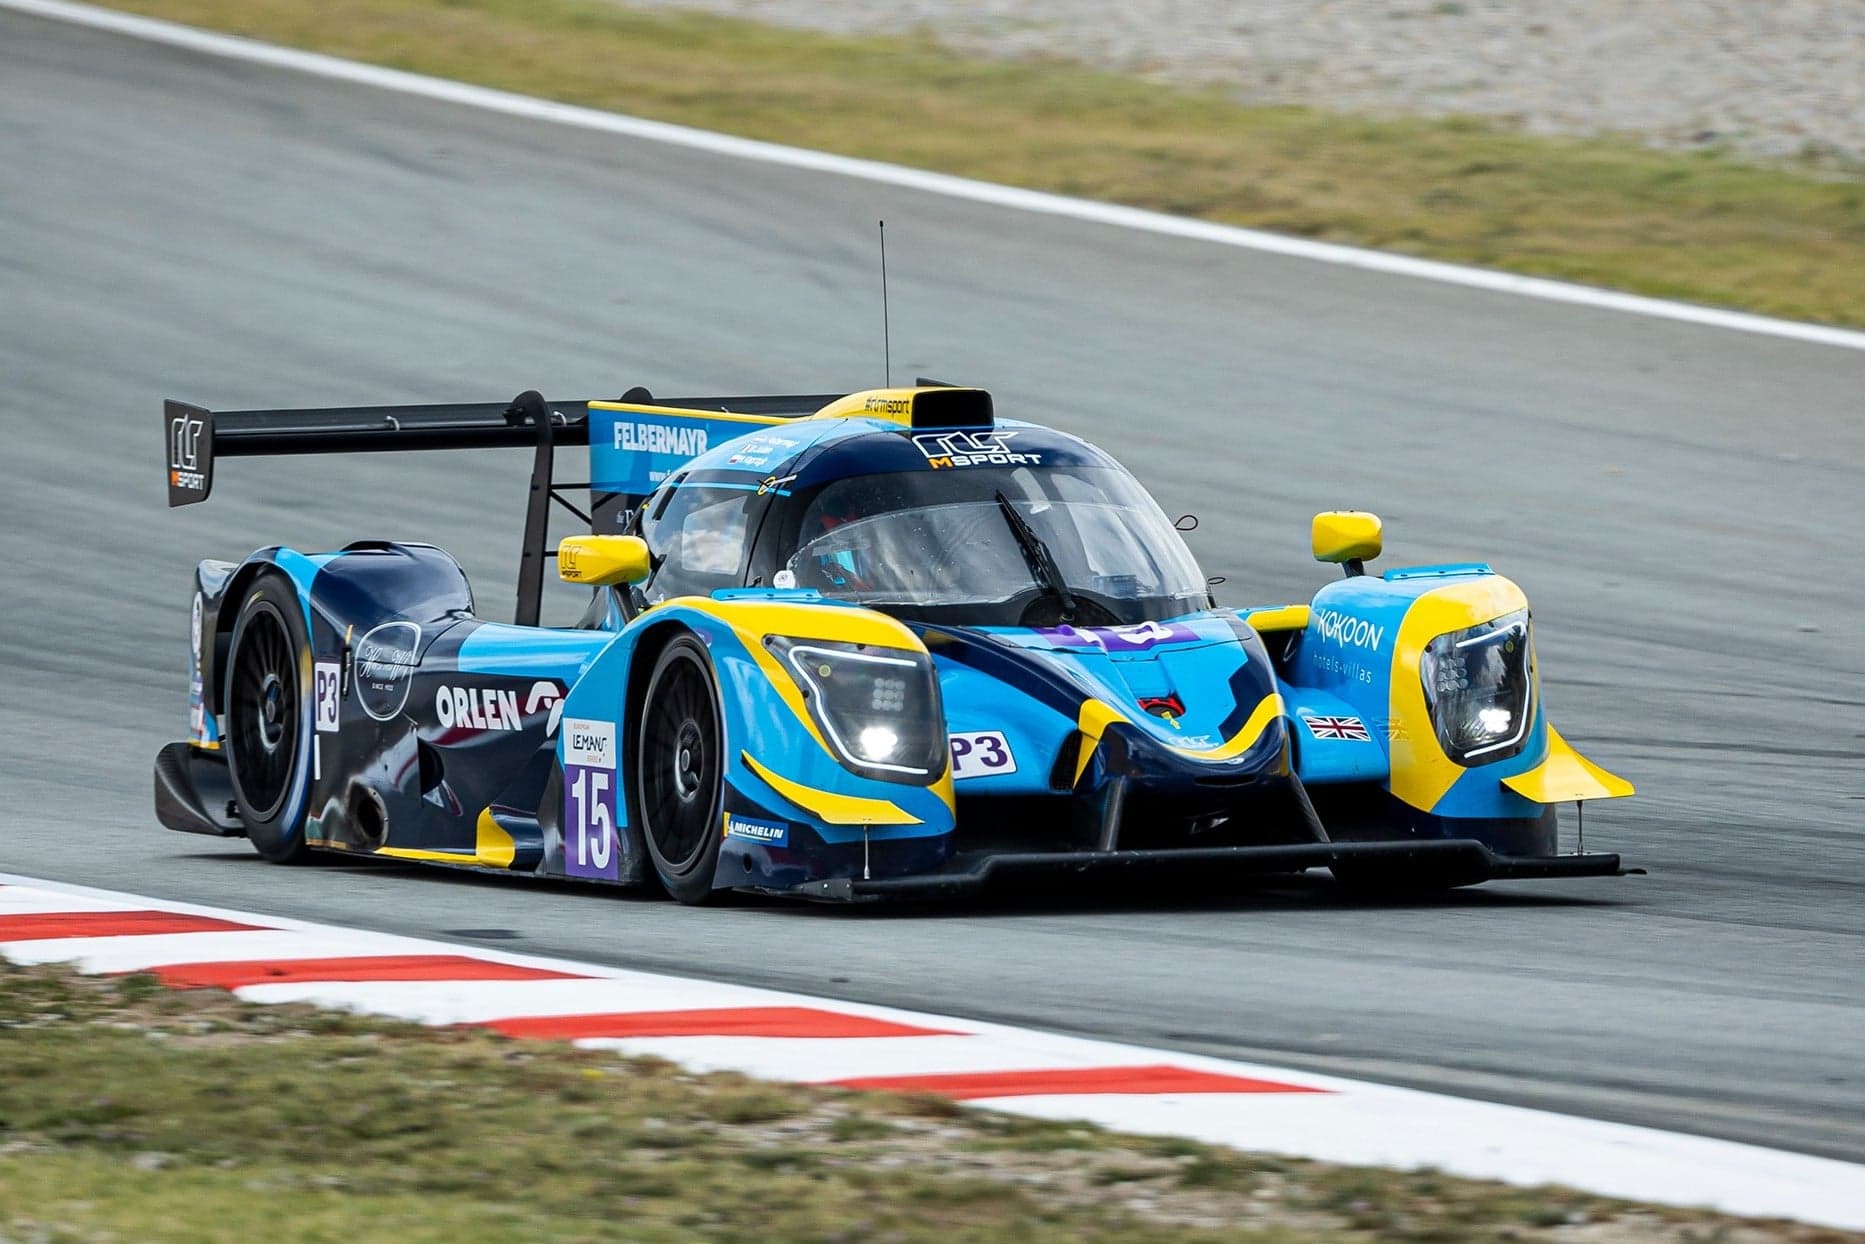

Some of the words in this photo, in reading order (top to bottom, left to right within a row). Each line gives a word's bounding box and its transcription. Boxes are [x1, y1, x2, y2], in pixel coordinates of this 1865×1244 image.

[613, 421, 708, 456] FELBERMAYR
[927, 453, 1042, 470] MSPORT
[1316, 607, 1384, 652] KOKOON
[317, 670, 338, 723] P3
[435, 684, 523, 731] ORLEN
[949, 735, 1009, 771] P3
[571, 768, 611, 869] 15
[734, 821, 784, 839] MICHELIN
